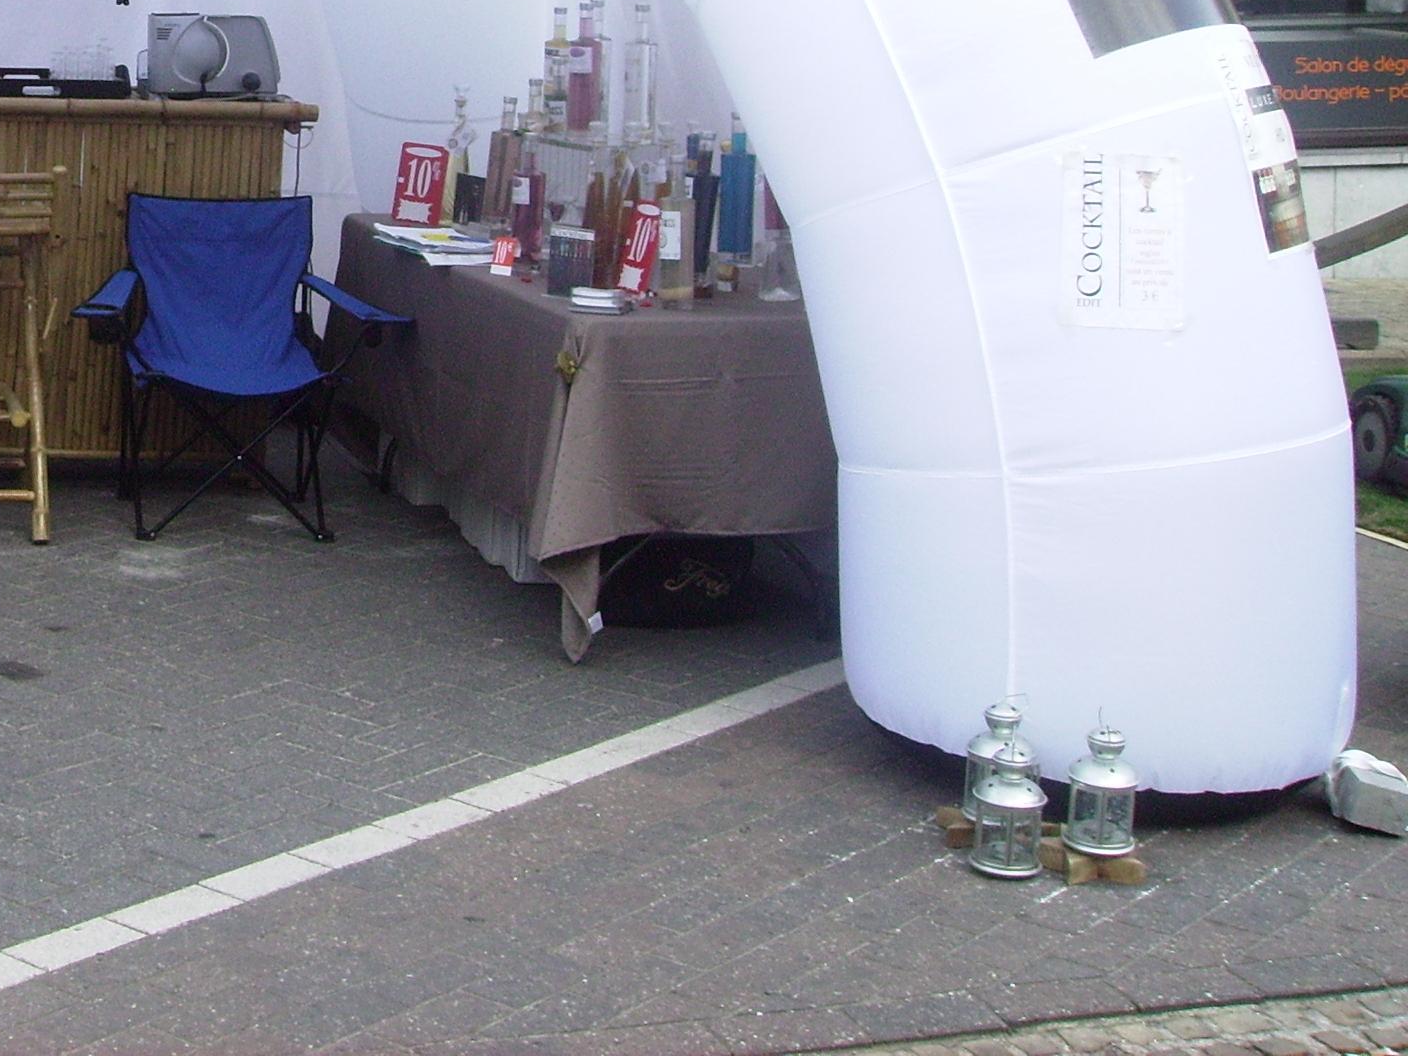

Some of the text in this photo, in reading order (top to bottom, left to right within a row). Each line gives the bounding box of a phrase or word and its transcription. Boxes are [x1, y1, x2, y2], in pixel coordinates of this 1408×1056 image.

[1295, 56, 1408, 76] Salon de dég
[1076, 153, 1104, 297] COCKTAIL
[1076, 298, 1102, 308] EDIT
